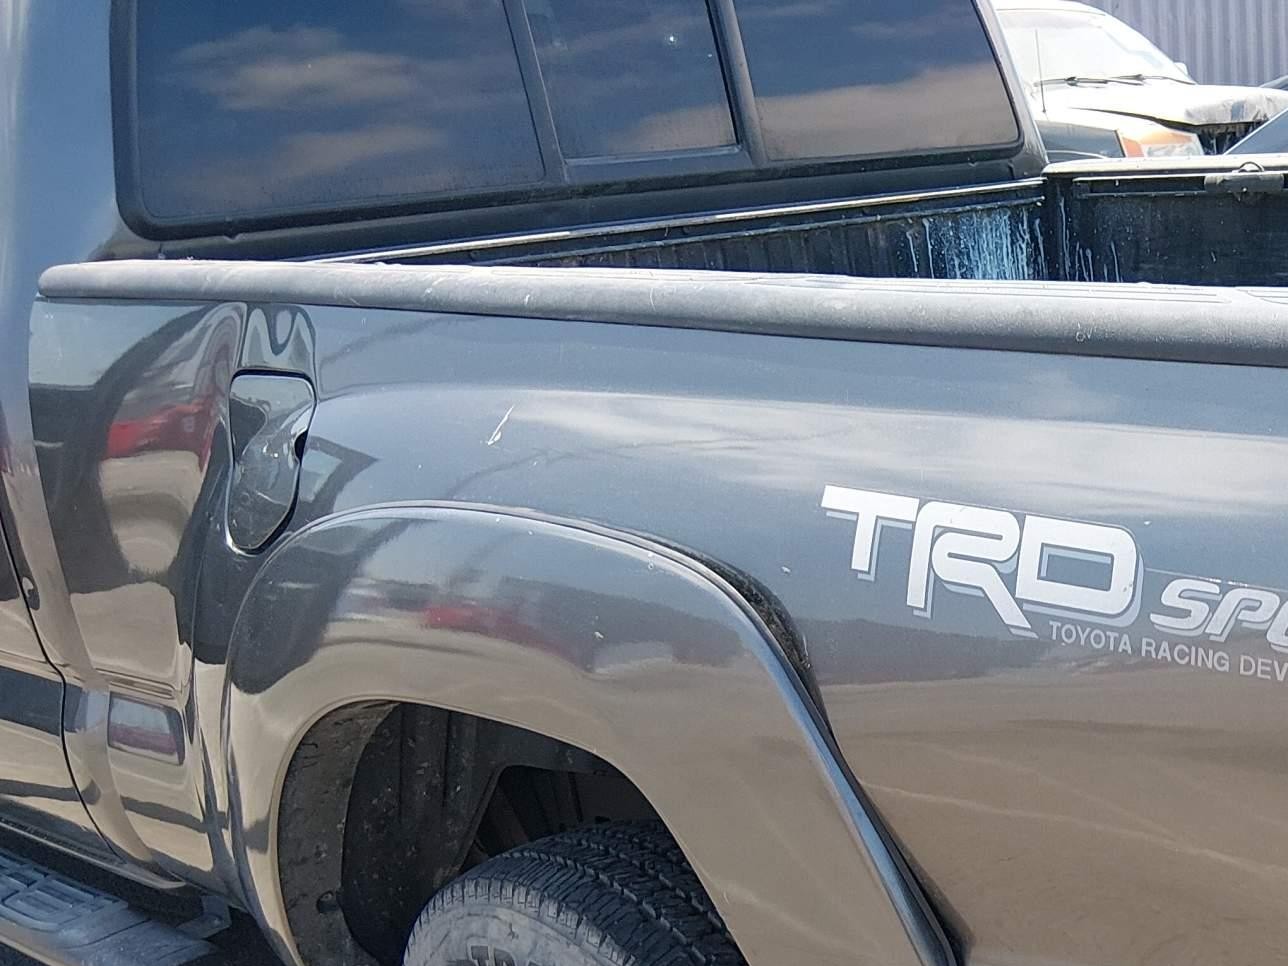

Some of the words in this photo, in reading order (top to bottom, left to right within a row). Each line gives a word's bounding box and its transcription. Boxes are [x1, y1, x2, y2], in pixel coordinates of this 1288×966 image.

[821, 484, 1144, 638] TRD
[1048, 620, 1133, 657] TOYOTA
[1139, 637, 1230, 673] RACING
